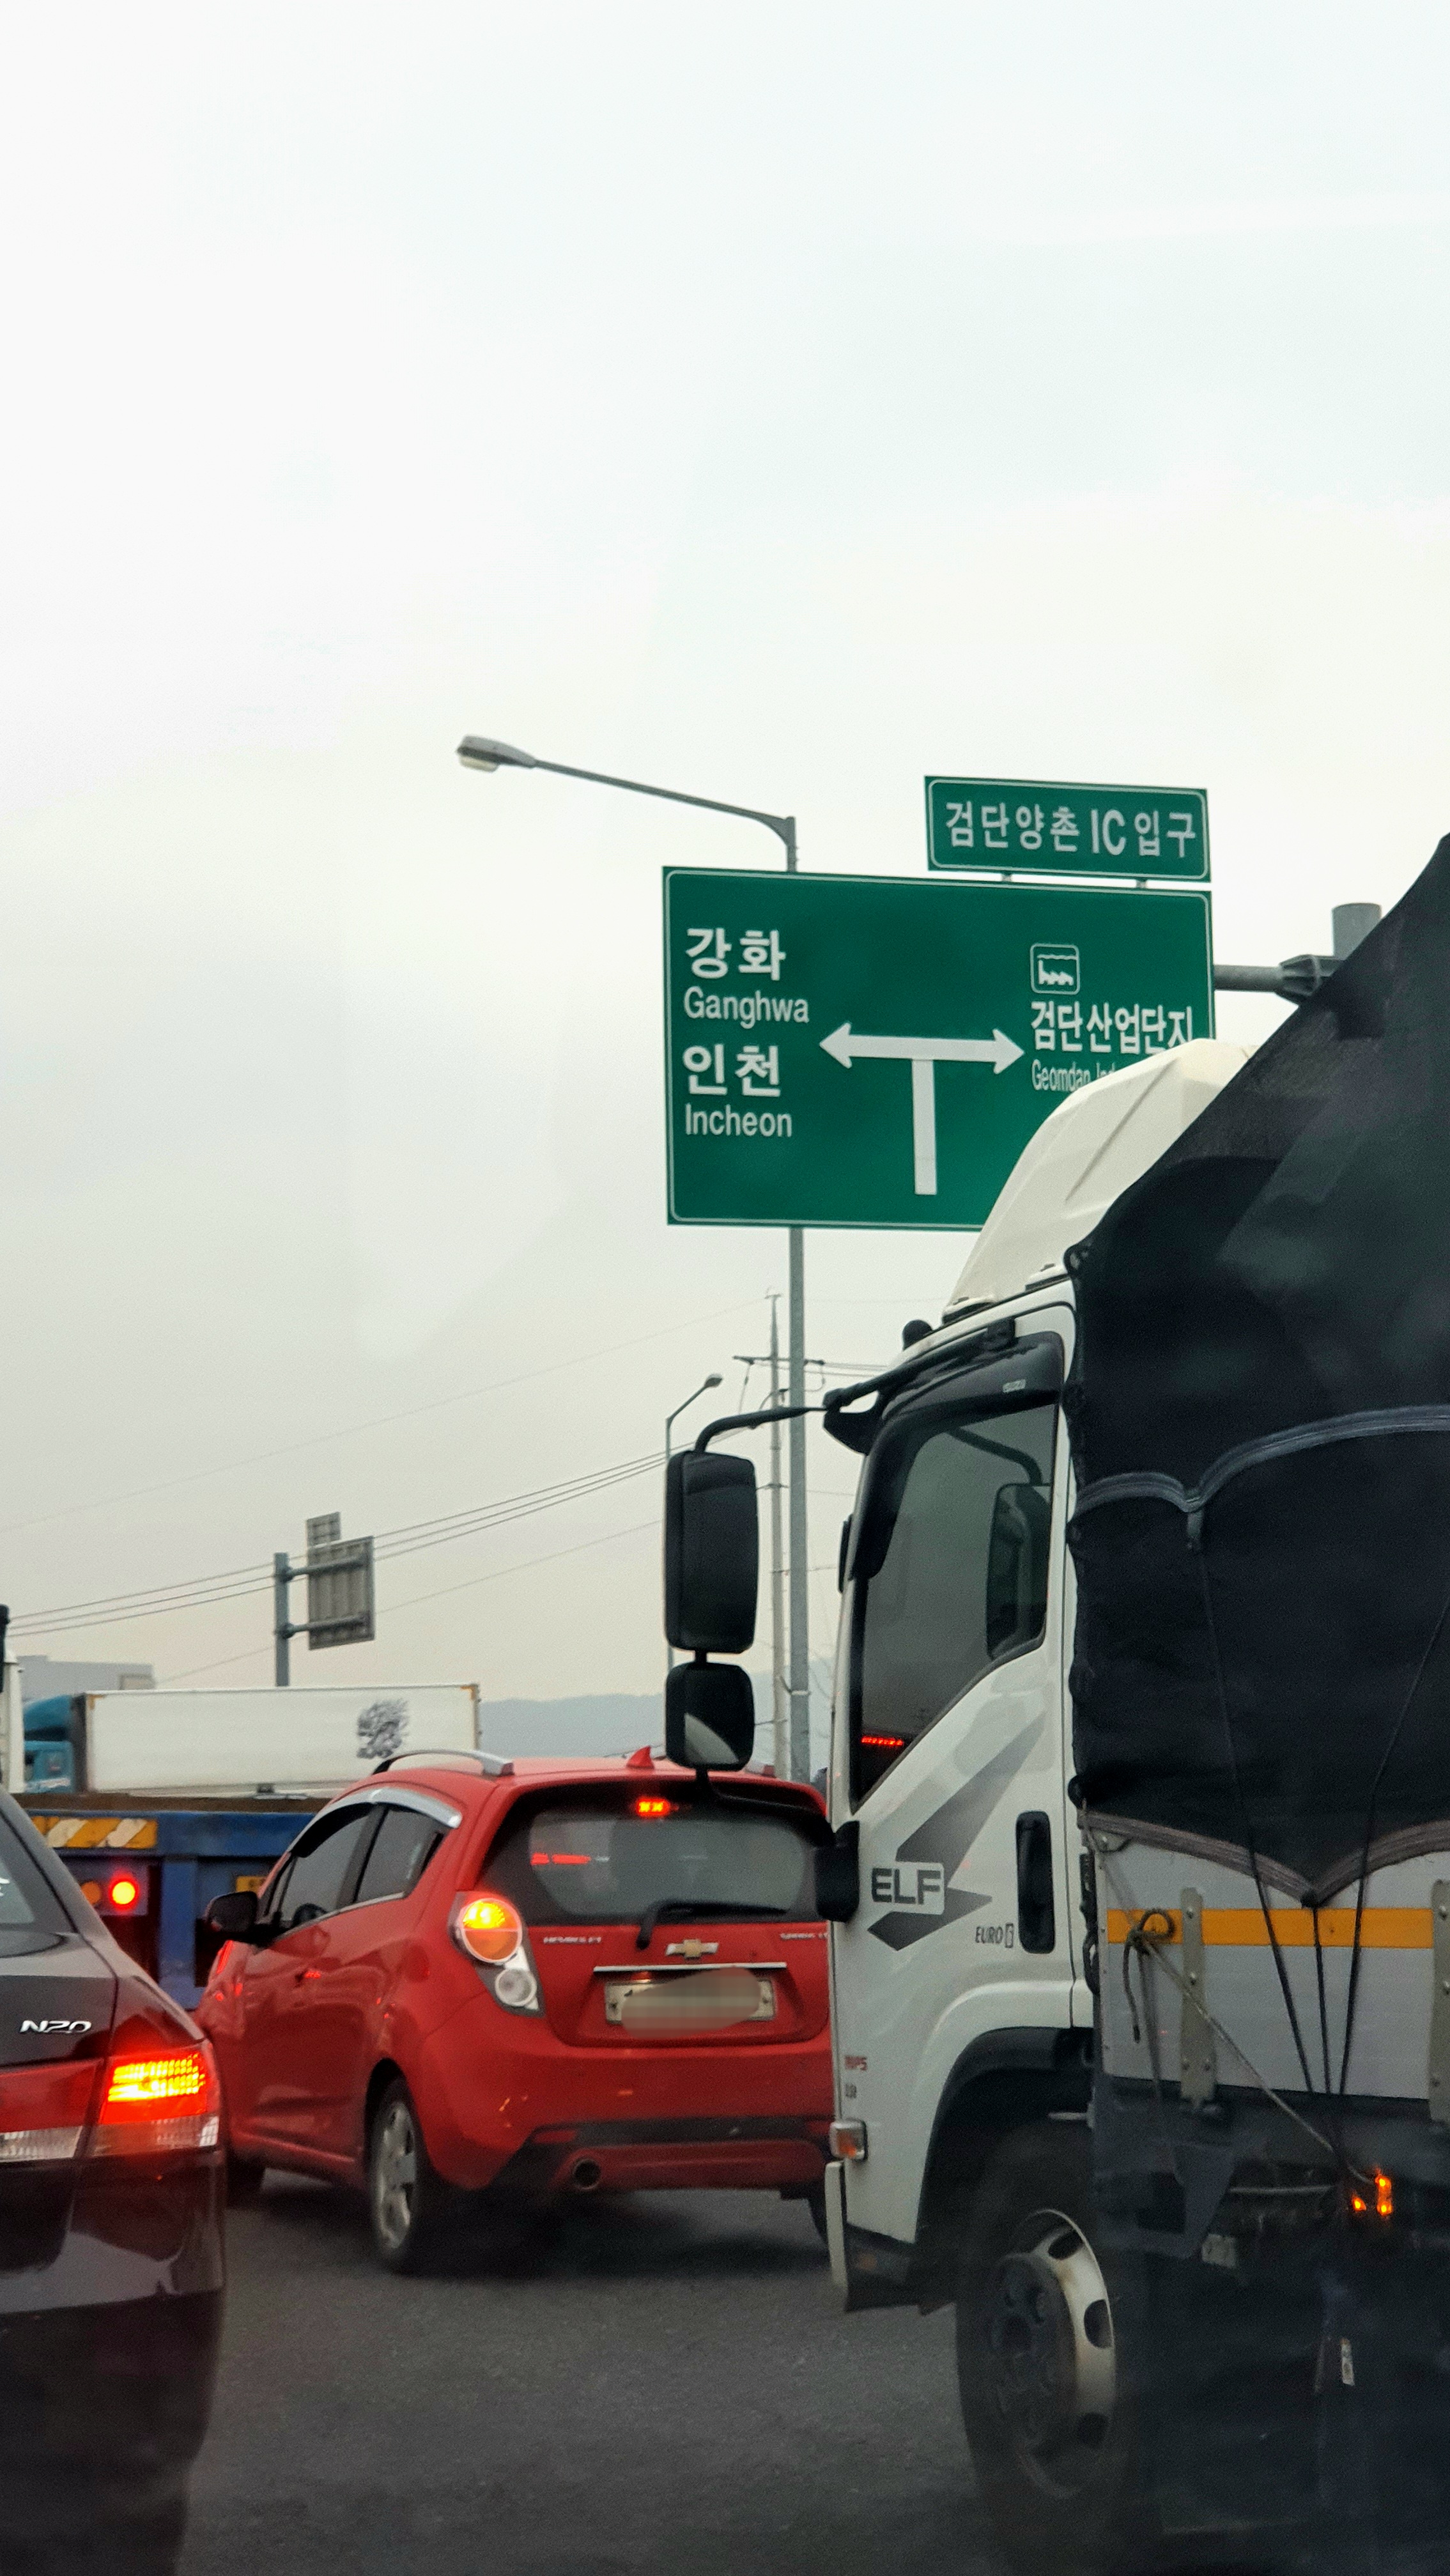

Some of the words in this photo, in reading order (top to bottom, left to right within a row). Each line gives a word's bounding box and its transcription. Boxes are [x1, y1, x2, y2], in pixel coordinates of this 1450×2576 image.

[686, 928, 787, 981] 강화
[684, 986, 810, 1029] Ganghwa
[1031, 1000, 1193, 1054] 검단산업단지
[683, 1043, 781, 1097] 인천
[1031, 1059, 1091, 1091] Geomdan
[685, 1103, 792, 1137] Incheon
[871, 1868, 941, 1905] ELF
[19, 2020, 92, 2034] N20
